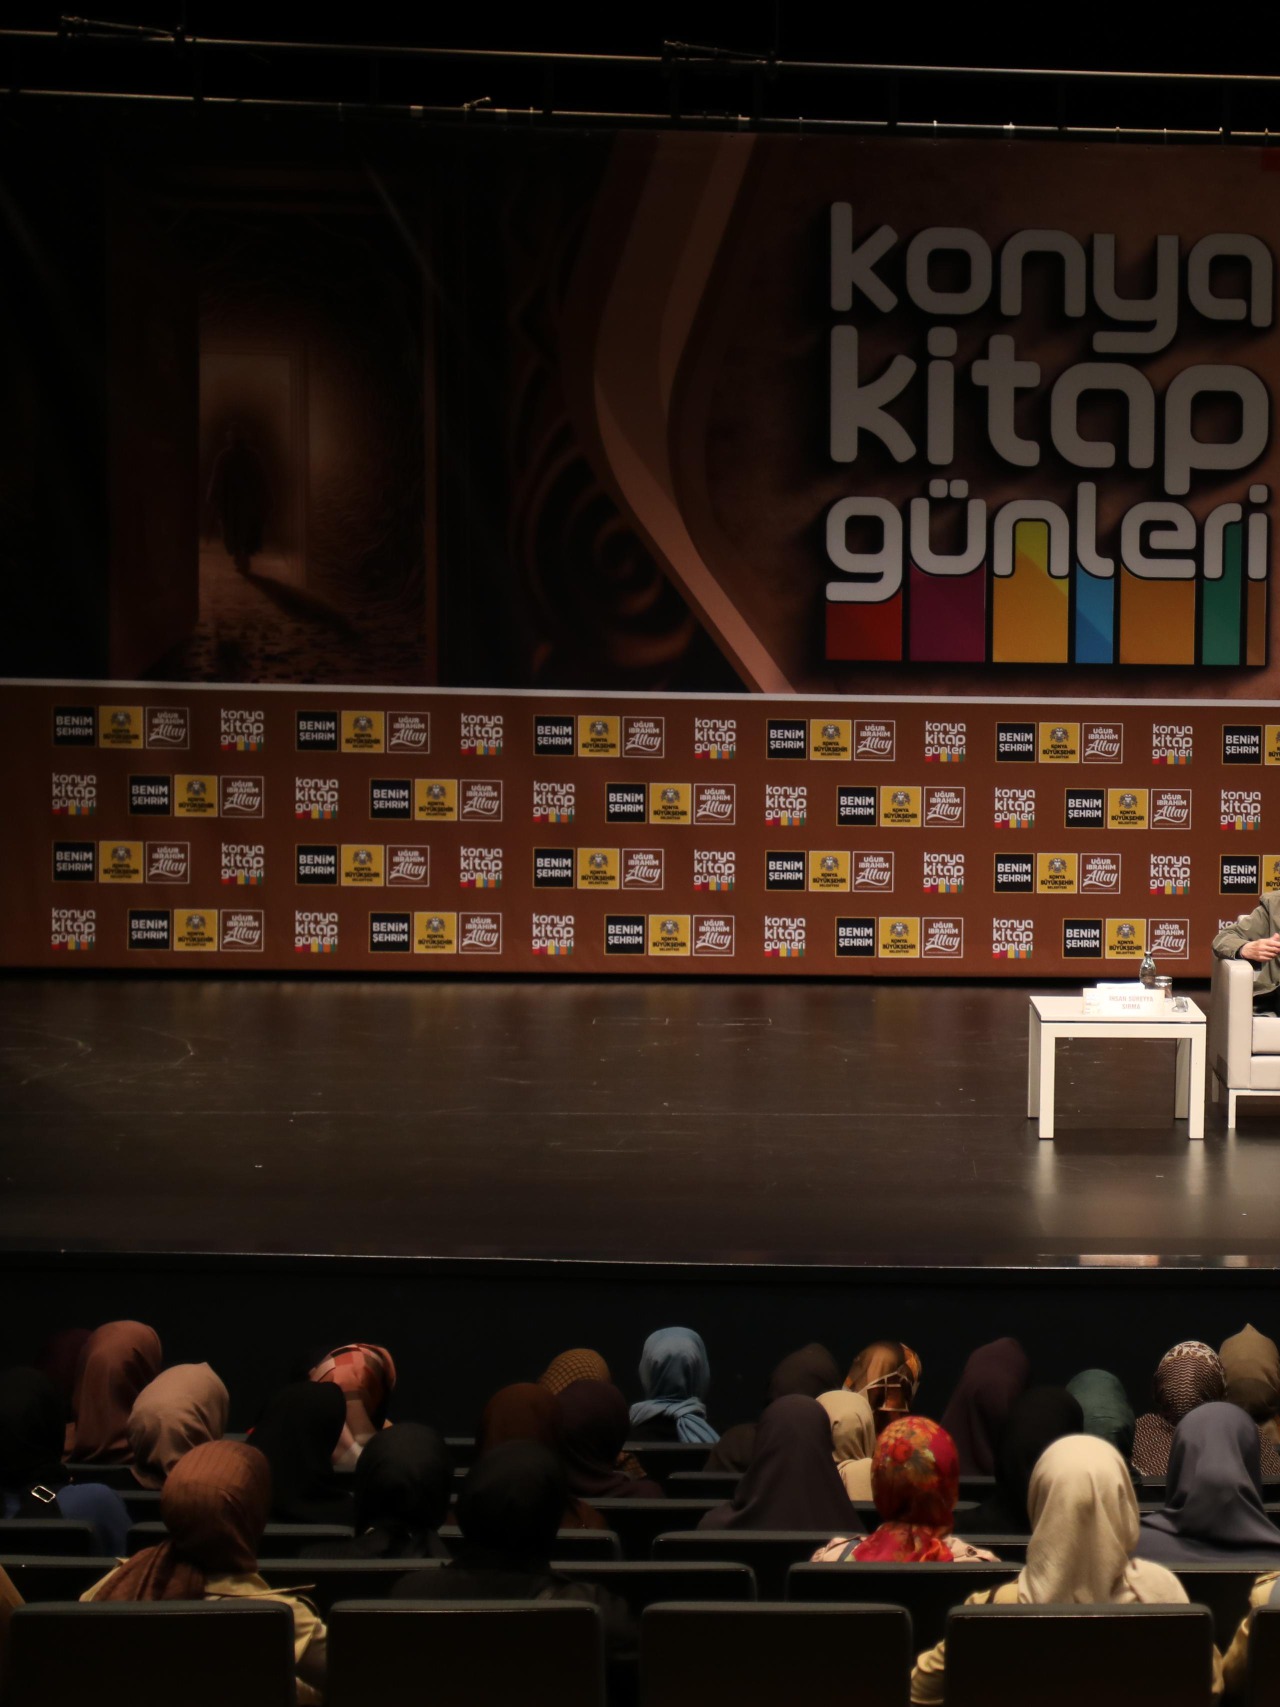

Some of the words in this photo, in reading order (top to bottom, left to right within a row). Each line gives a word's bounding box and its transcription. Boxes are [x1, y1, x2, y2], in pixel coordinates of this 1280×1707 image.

[831, 202, 1273, 354] konya
[830, 325, 1270, 496] kitap
[826, 479, 1269, 602] günleri
[222, 719, 263, 735] kitap
[694, 717, 736, 731] konya
[1152, 724, 1193, 737] konya
[694, 728, 736, 744] kitap
[1152, 735, 1192, 750] kitap
[53, 784, 95, 800] kitap
[533, 781, 575, 794] konya
[994, 787, 1035, 800] konya
[533, 792, 574, 807] kitap
[994, 798, 1034, 812] kitap
[460, 846, 502, 860] konya
[923, 852, 964, 865] konya
[460, 857, 502, 873] kitap
[923, 863, 963, 878] kitap
[296, 910, 338, 924] konya
[764, 915, 806, 928] konya
[296, 921, 337, 937] kitap
[764, 926, 806, 941] kitap
